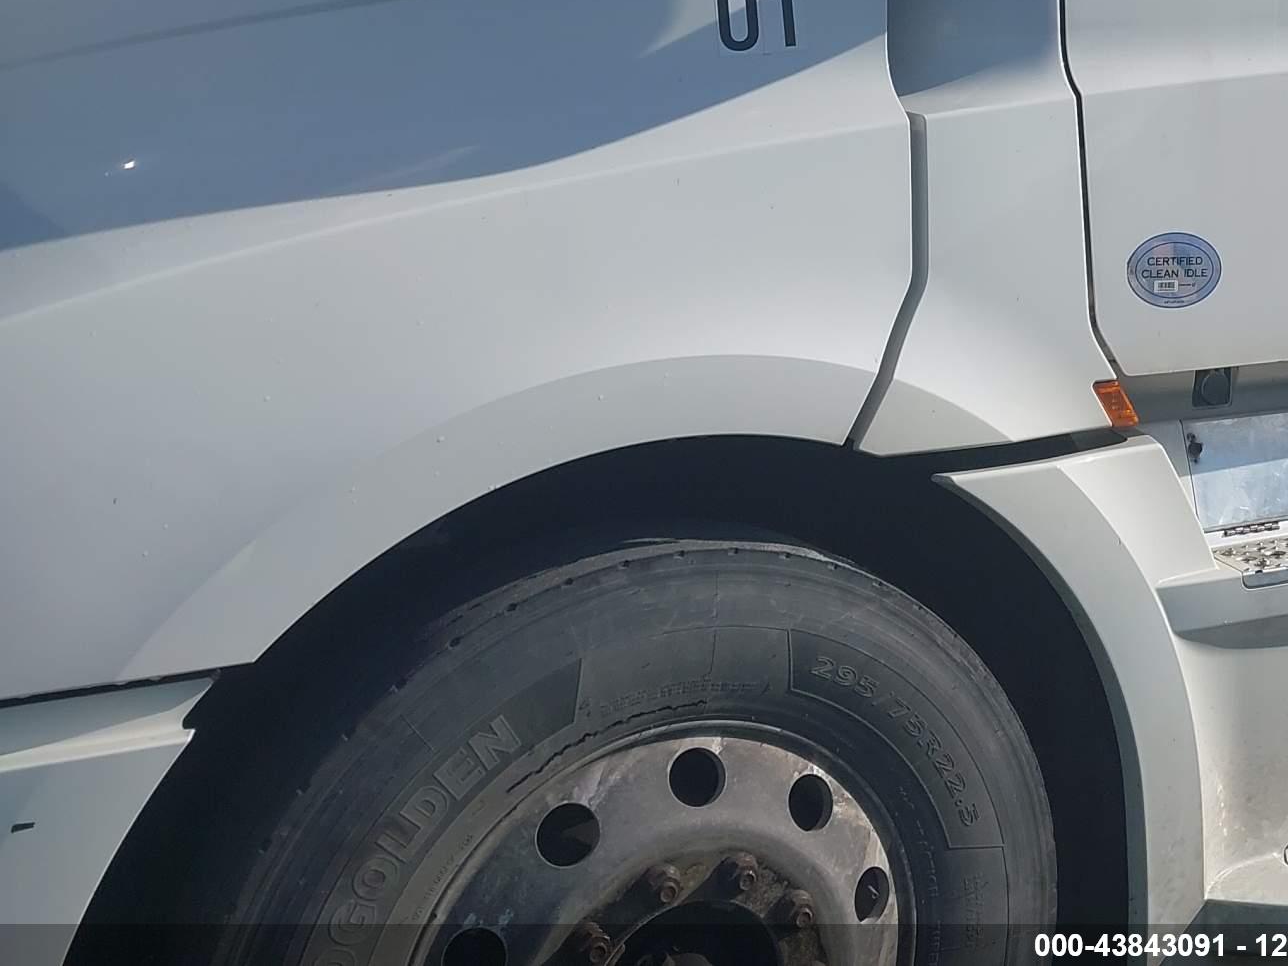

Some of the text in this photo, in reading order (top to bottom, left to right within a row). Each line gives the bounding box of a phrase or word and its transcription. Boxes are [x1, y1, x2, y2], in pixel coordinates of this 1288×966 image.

[1147, 256, 1203, 266] CERTIFIED
[1141, 268, 1209, 279] CLEAN IDLE
